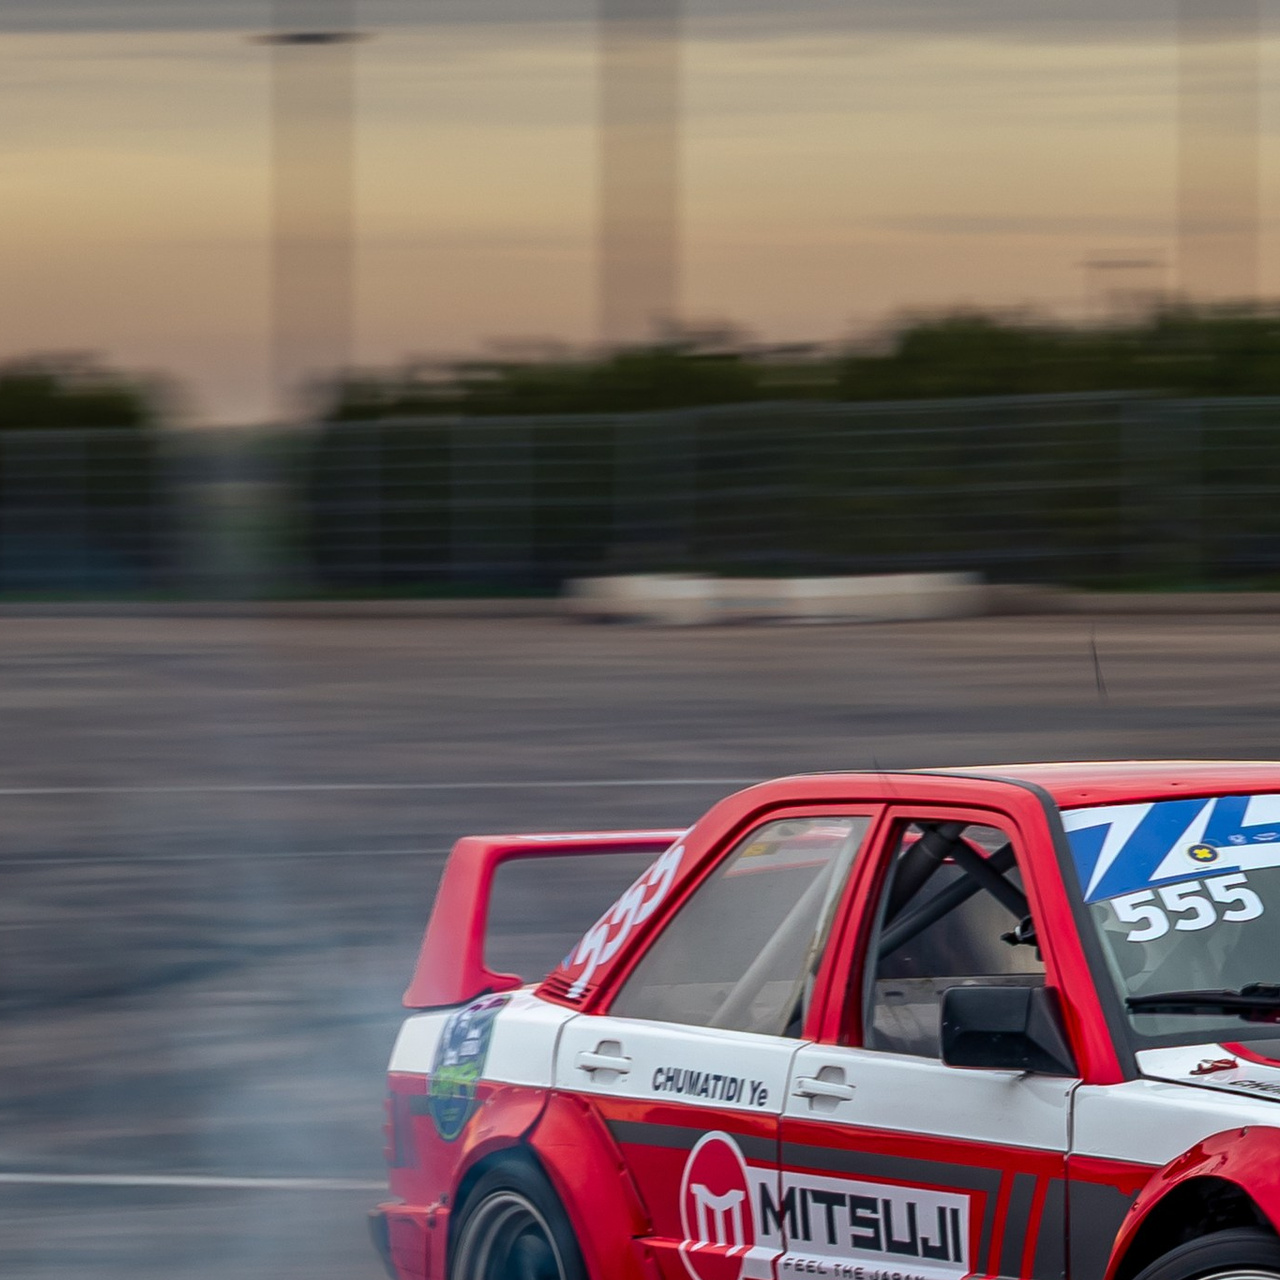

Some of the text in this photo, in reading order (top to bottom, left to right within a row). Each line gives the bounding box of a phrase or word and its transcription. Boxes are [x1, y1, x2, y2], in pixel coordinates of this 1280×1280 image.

[1110, 872, 1264, 942] 555
[748, 1079, 769, 1107] Ye
[759, 1182, 963, 1263] MITSUJI
[783, 1257, 827, 1274] FEEL
[834, 1264, 865, 1280] THE
